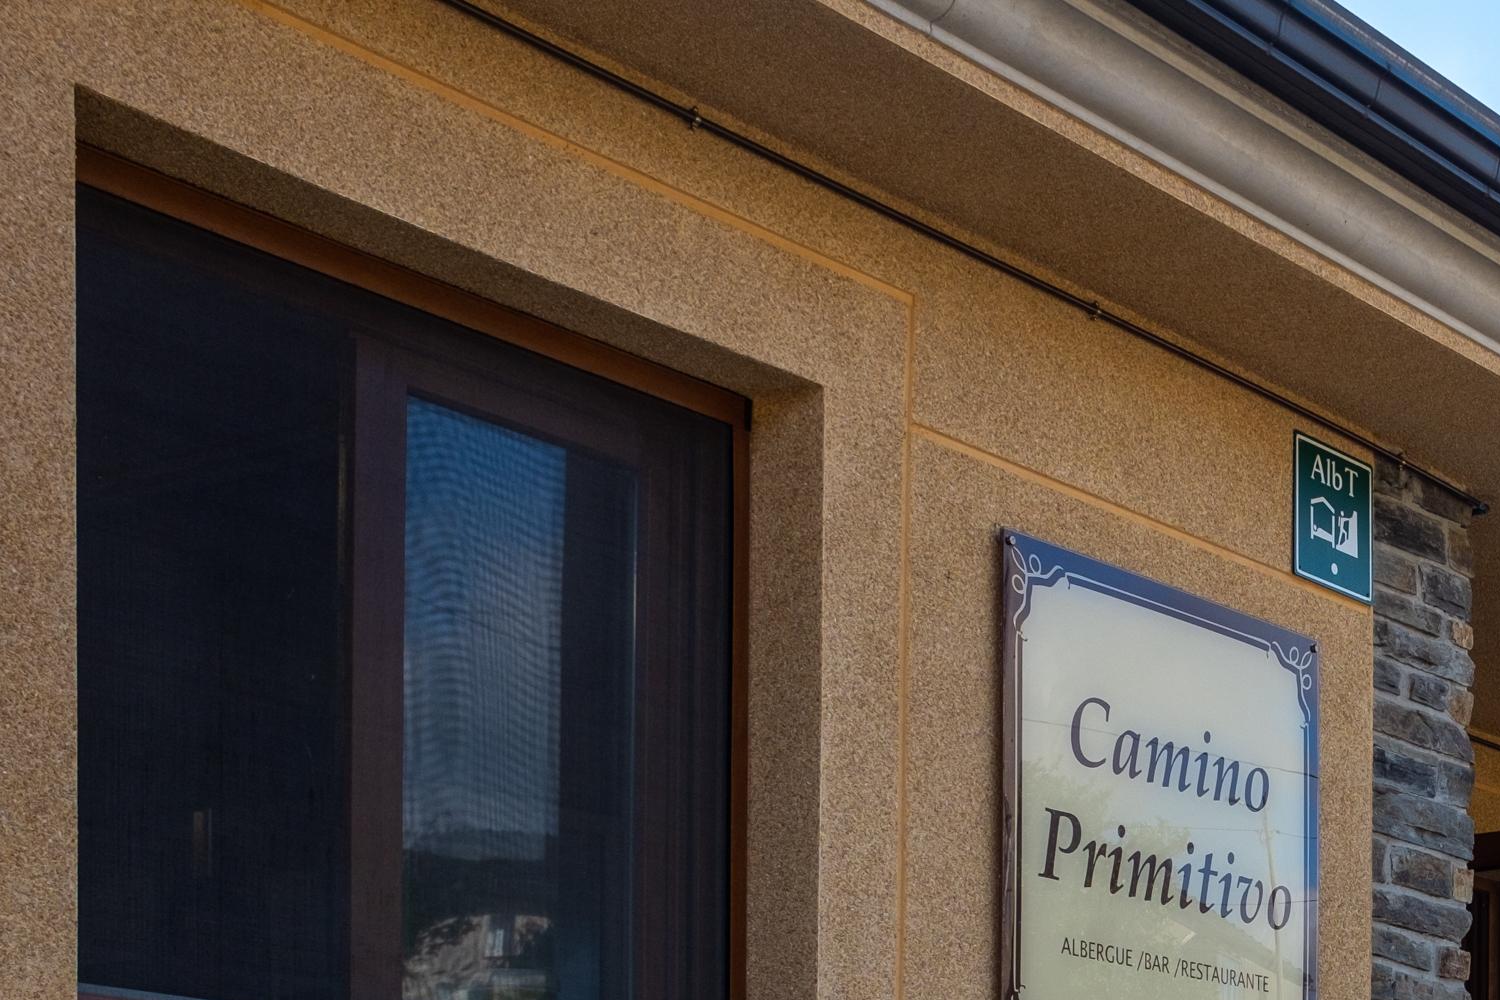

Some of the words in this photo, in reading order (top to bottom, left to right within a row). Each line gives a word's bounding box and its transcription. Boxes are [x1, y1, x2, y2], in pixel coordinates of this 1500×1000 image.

[1070, 697, 1270, 813] Camino
[1037, 807, 1292, 931] Primitivo
[1061, 936, 1133, 967] ALBERGUE
[1136, 951, 1170, 974] /BAR
[1173, 958, 1270, 993] /RESTAURANTE
